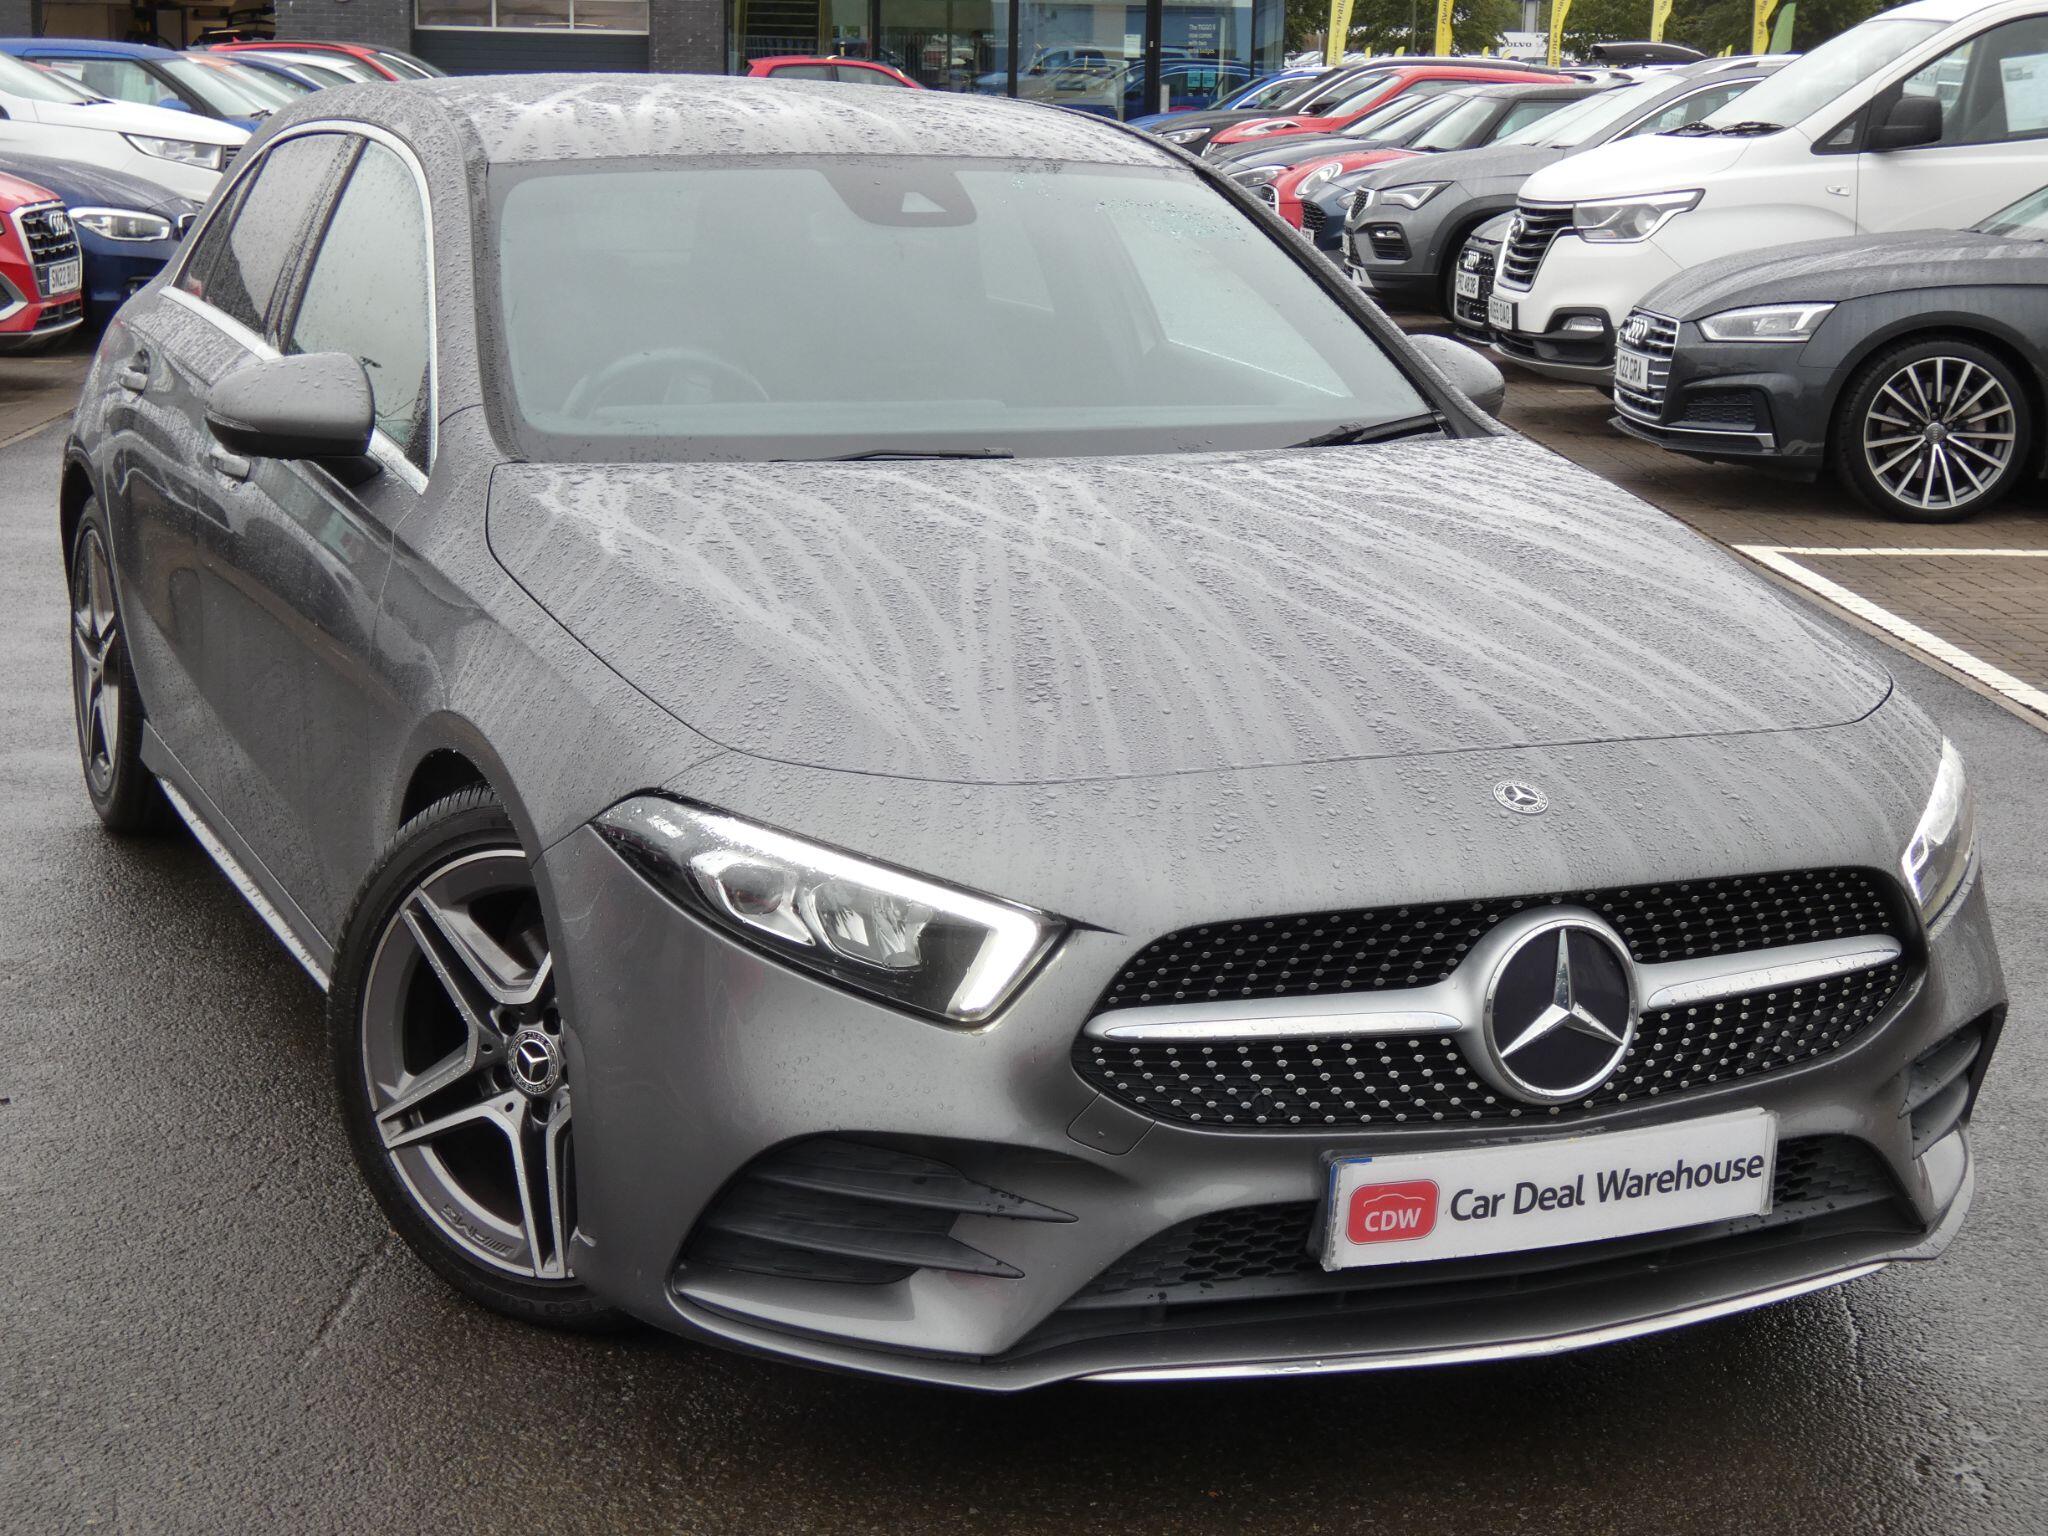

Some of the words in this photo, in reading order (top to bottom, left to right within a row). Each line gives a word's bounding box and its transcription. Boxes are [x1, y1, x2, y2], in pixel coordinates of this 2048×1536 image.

[1450, 1188, 1506, 1221] Car
[1513, 1174, 1586, 1215] Deal
[1596, 1154, 1765, 1203] Warehouse
[1364, 1207, 1422, 1232] CDW
